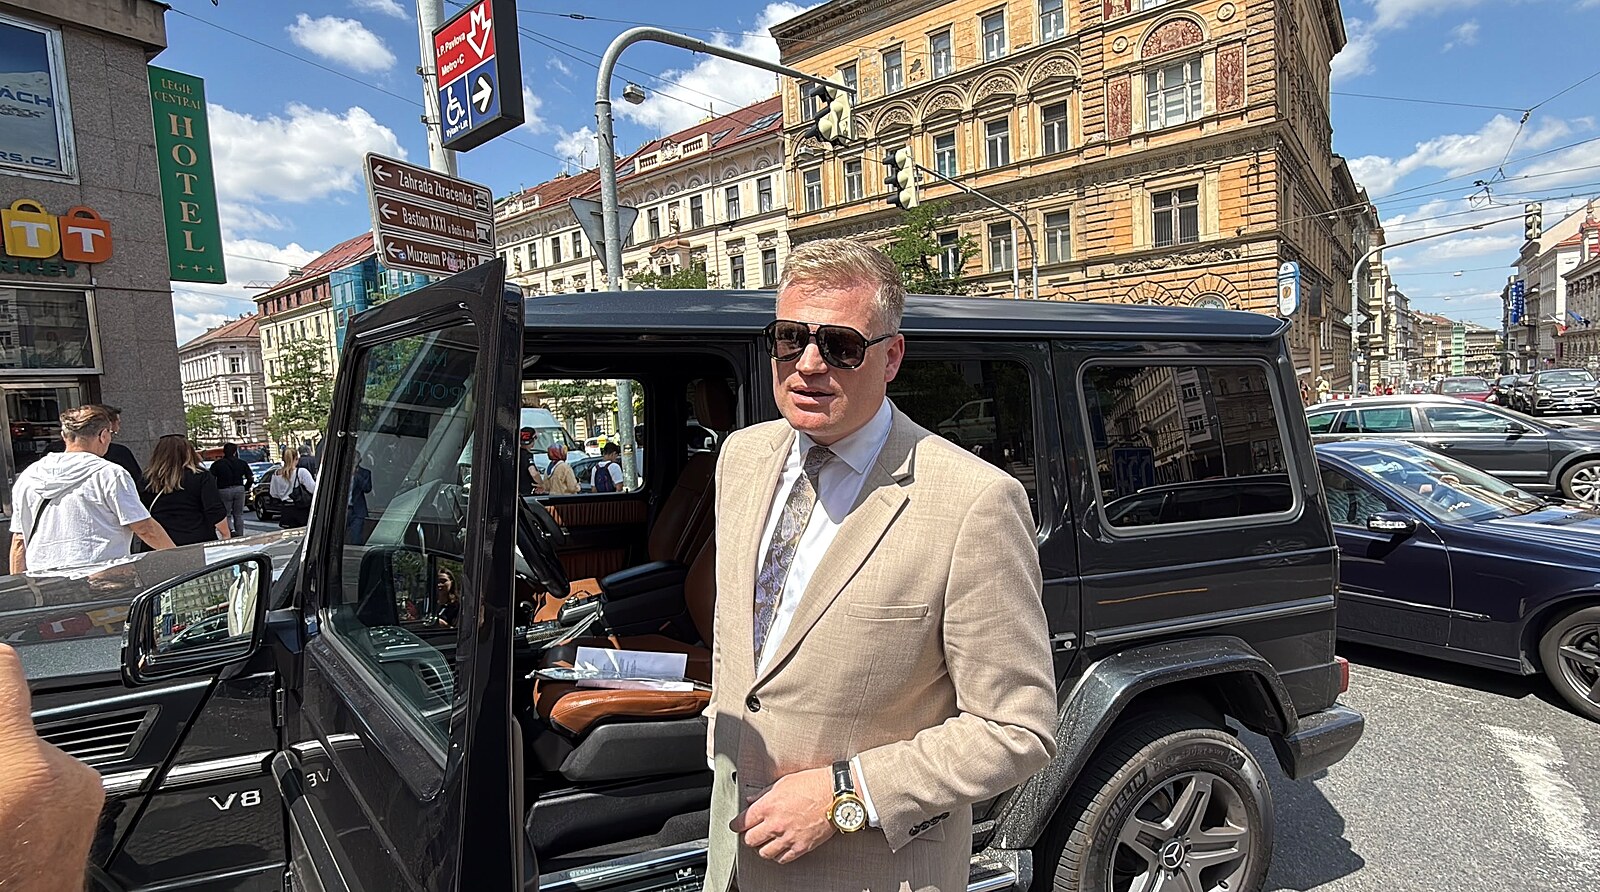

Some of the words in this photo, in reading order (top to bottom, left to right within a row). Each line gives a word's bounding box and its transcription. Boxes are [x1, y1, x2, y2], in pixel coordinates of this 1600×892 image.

[161, 78, 193, 95] LEGIE
[168, 112, 205, 253] HOTEL
[398, 170, 434, 196] Zahrada
[433, 180, 473, 206] Ztracenka
[402, 207, 430, 229] Bastion
[406, 244, 441, 267] Muzeum
[208, 788, 261, 811] V8
[1095, 772, 1145, 850] MICHELIN
